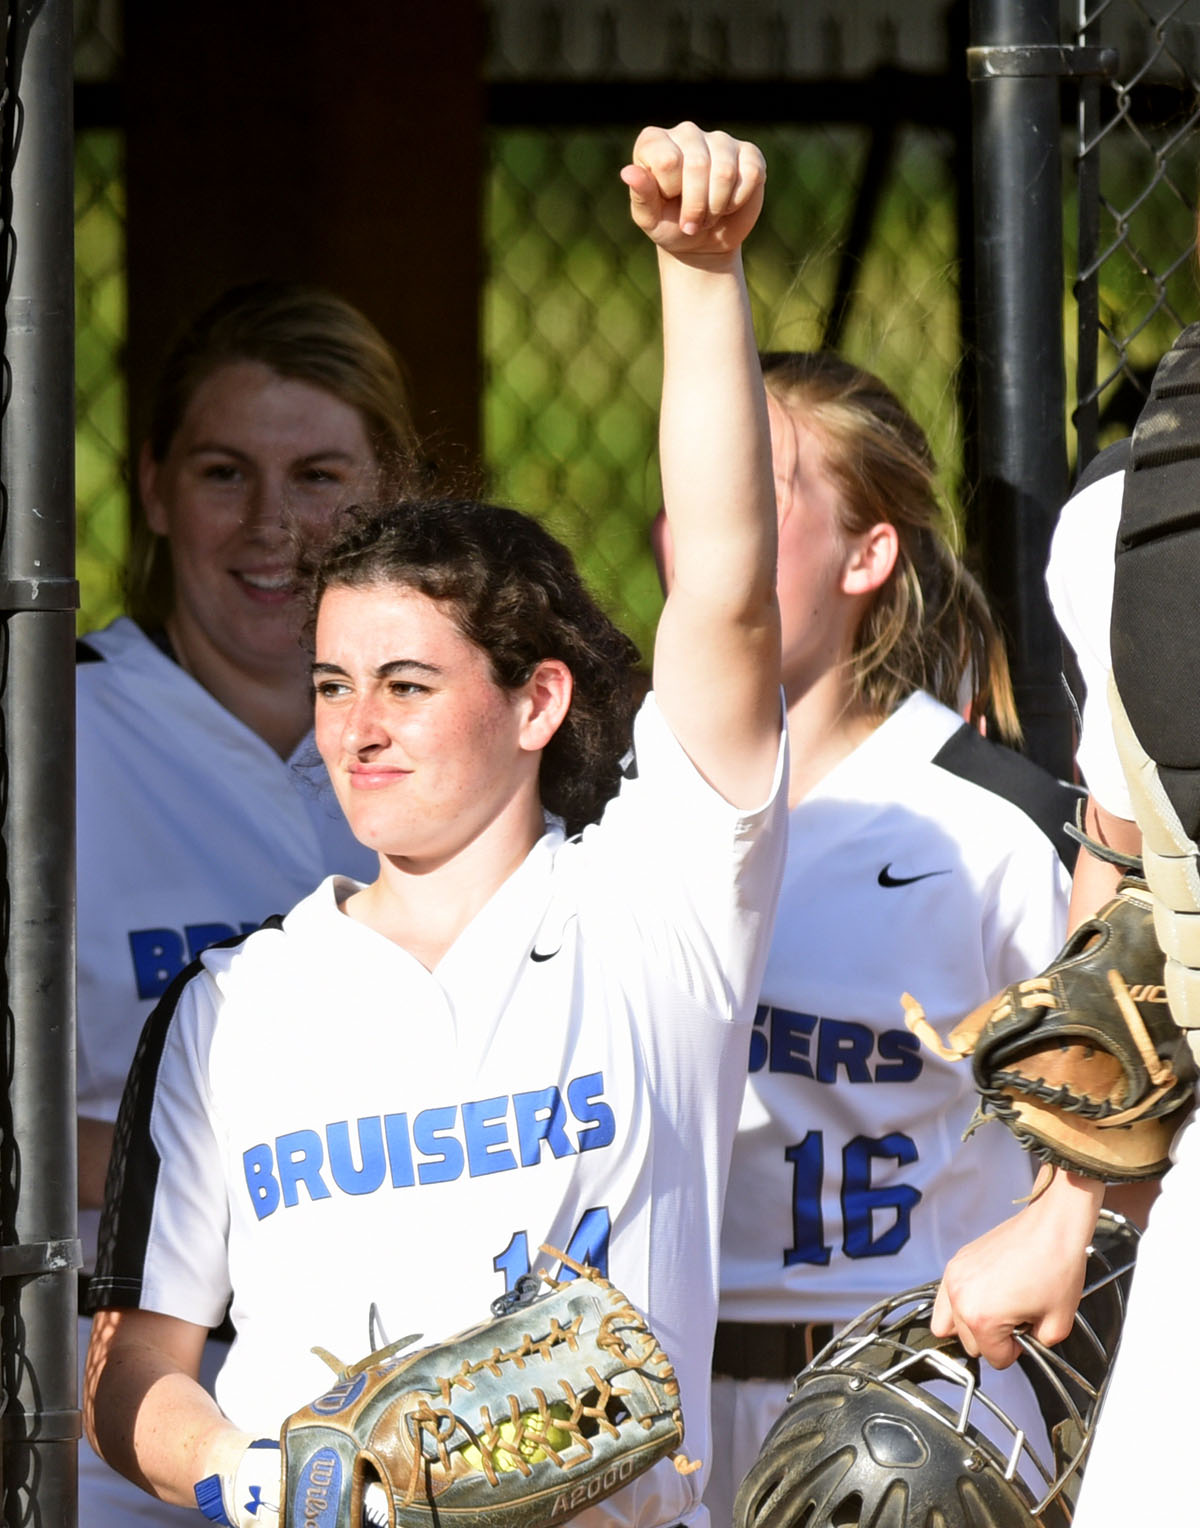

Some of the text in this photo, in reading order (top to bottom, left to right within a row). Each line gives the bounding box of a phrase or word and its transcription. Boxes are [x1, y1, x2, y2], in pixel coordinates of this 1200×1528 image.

[243, 1071, 616, 1221] BRUISERS
[783, 1130, 922, 1267] 16
[552, 1458, 634, 1517] A2000
